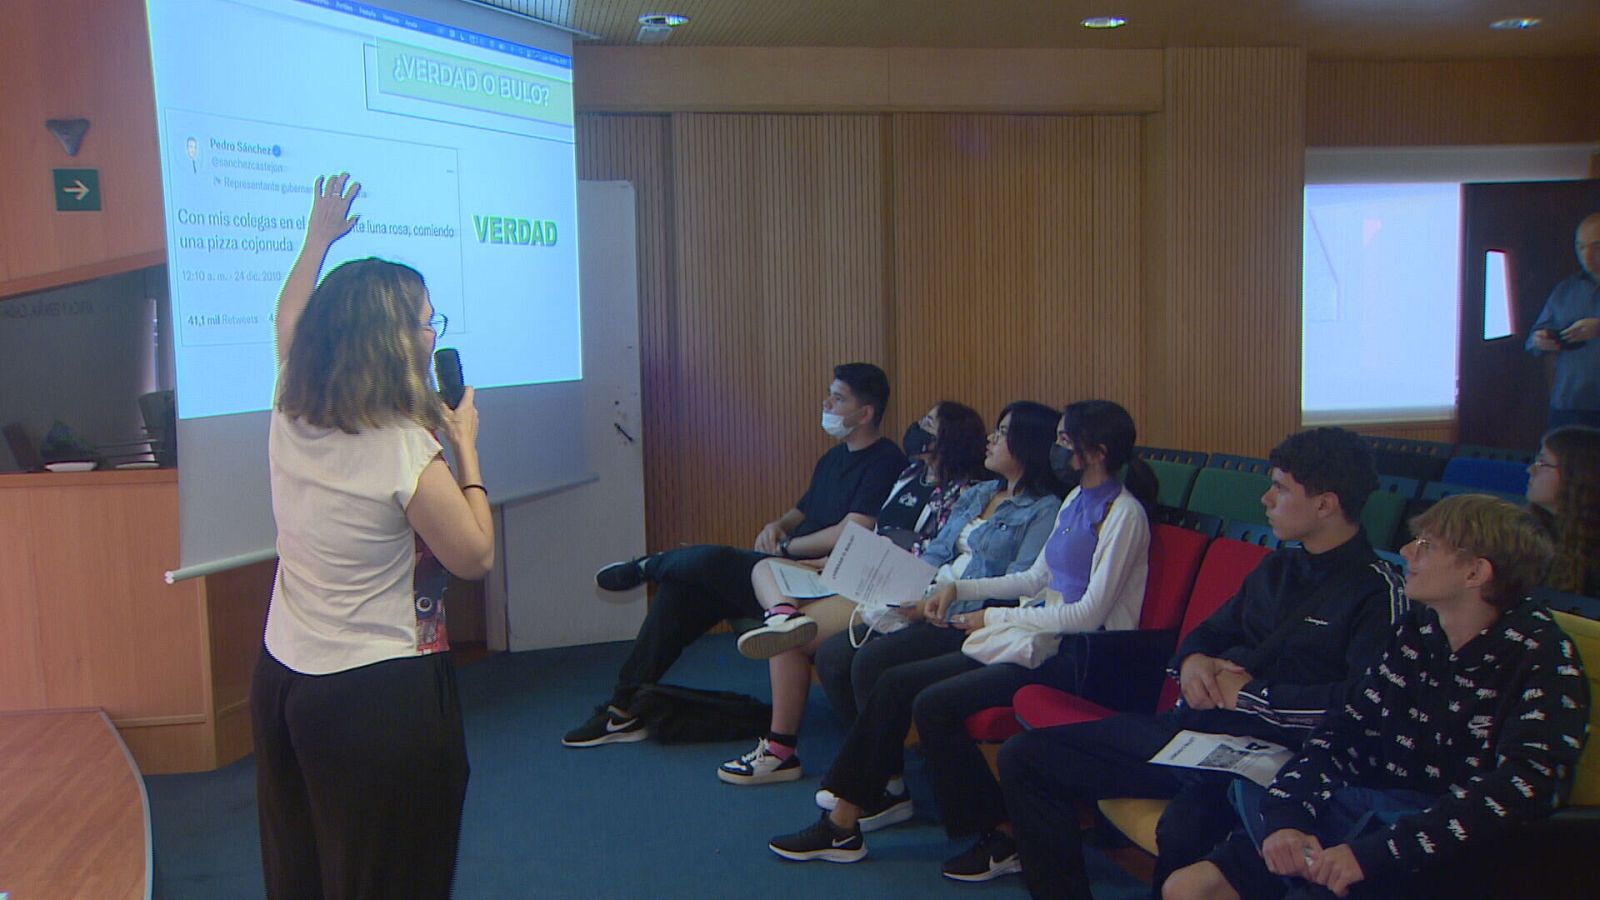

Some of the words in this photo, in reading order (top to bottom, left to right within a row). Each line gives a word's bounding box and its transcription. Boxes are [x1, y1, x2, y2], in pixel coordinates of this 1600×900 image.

[392, 54, 478, 92] ¿VERDAD
[482, 75, 497, 95] O
[499, 77, 551, 107] BULO?
[210, 138, 235, 152] Pedro
[237, 140, 271, 156] Sánchez
[224, 176, 280, 192] Representante
[177, 209, 206, 226] Con
[208, 211, 231, 228] mis
[233, 213, 277, 232] colegas
[279, 217, 294, 230] en
[296, 213, 306, 231] el
[366, 219, 387, 235] luna
[414, 221, 455, 238] comiendo
[472, 214, 558, 247] VERDAD
[179, 237, 205, 251] una
[207, 235, 239, 254] pizza
[241, 236, 294, 255] cojonuda
[182, 270, 205, 281] 12:10
[233, 270, 245, 281] 24
[188, 314, 205, 327] 41,1
[207, 314, 221, 326] mil
[222, 313, 259, 325] Retweets
